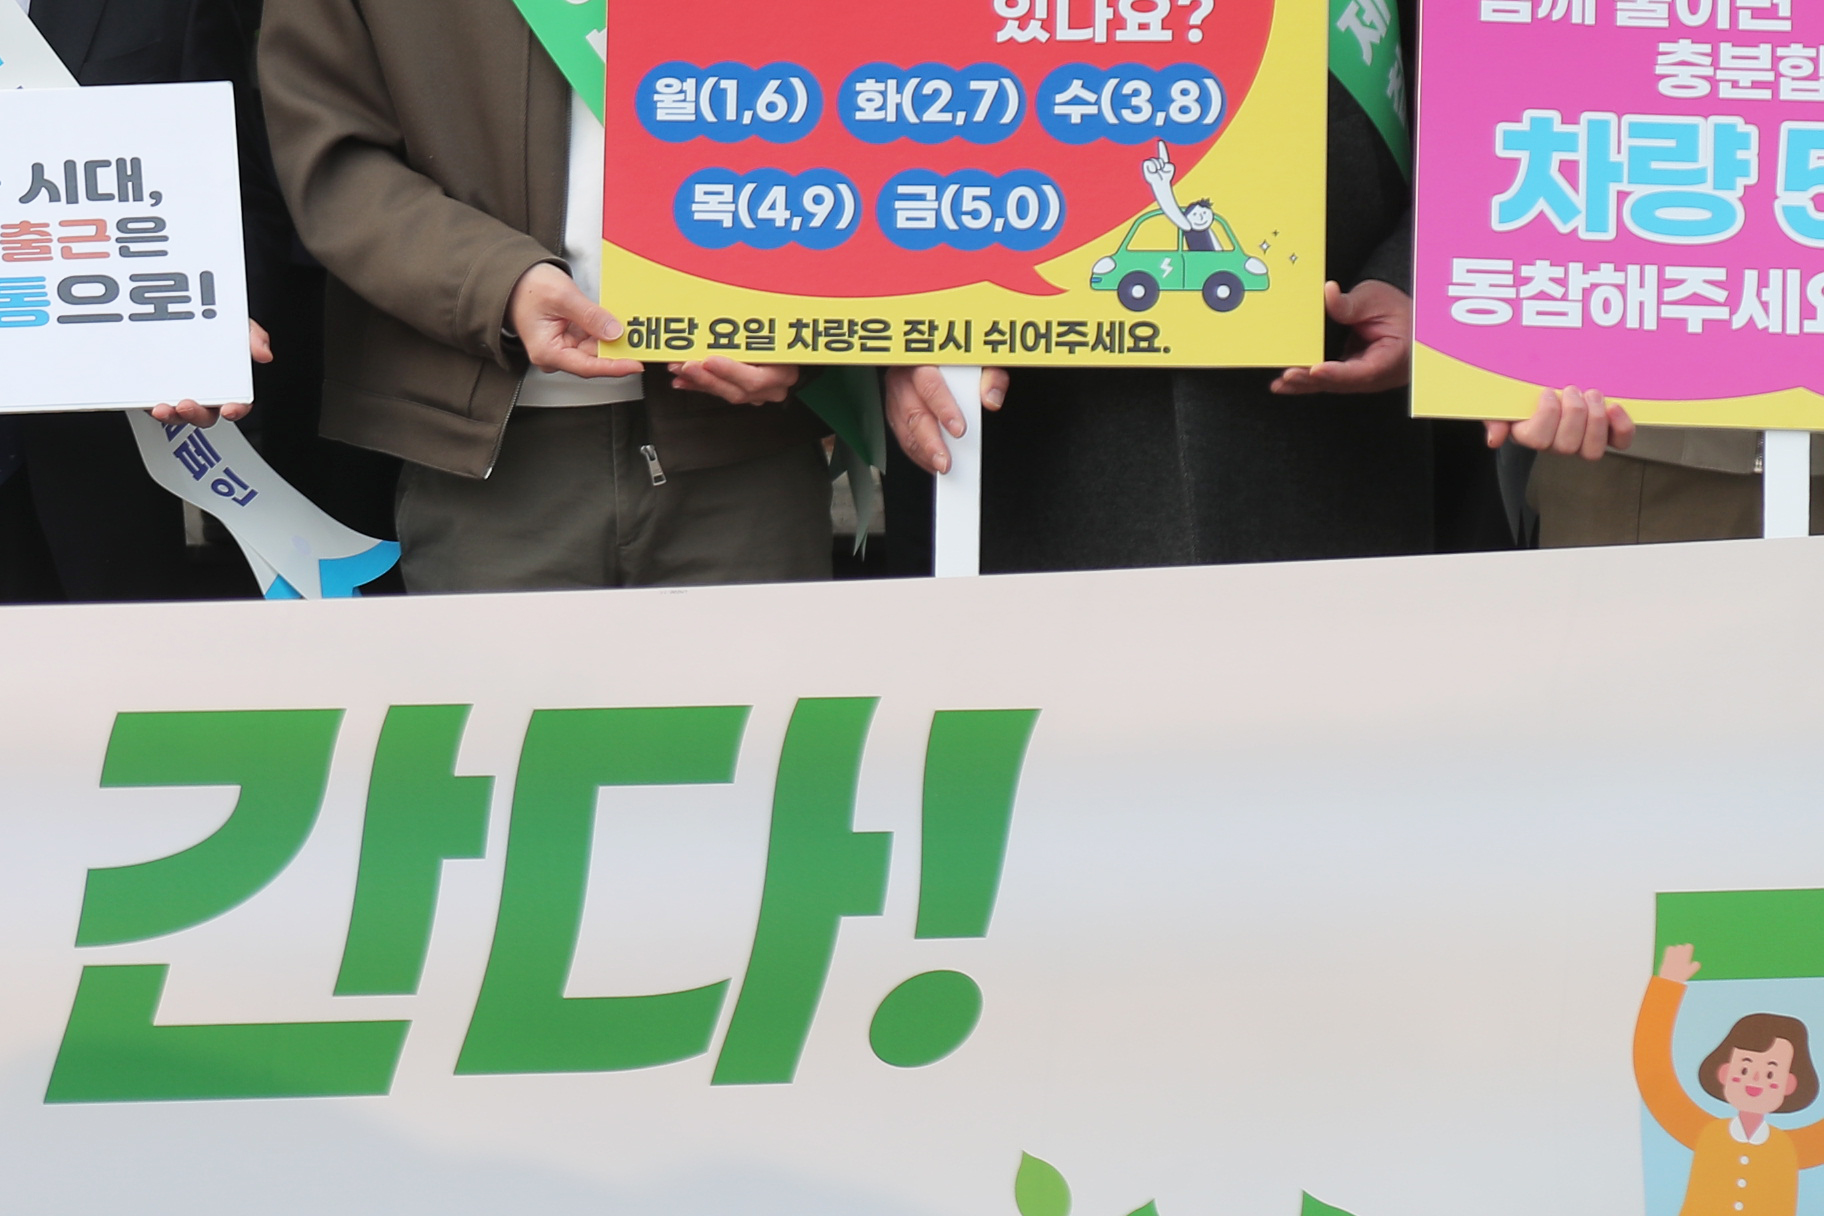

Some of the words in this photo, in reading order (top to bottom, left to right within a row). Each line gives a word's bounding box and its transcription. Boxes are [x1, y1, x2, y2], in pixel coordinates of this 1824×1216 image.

[651, 76, 810, 127] 월(1,6)
[853, 77, 1021, 127] 화(2,7)
[1053, 78, 1223, 127] 수(3,8)
[18, 156, 164, 208] 시대,
[1491, 108, 1760, 246] 차량
[691, 182, 858, 231] 목(4,9)
[893, 184, 1062, 233] 금(5,0)
[626, 317, 699, 353] 해당
[706, 317, 778, 353] 요일
[786, 318, 895, 354] 차량은
[903, 319, 976, 355] 잠시
[982, 319, 1173, 356] 쉬어주세요.
[161, 421, 260, 508] 페인
[42, 695, 1044, 1105] 간다!
